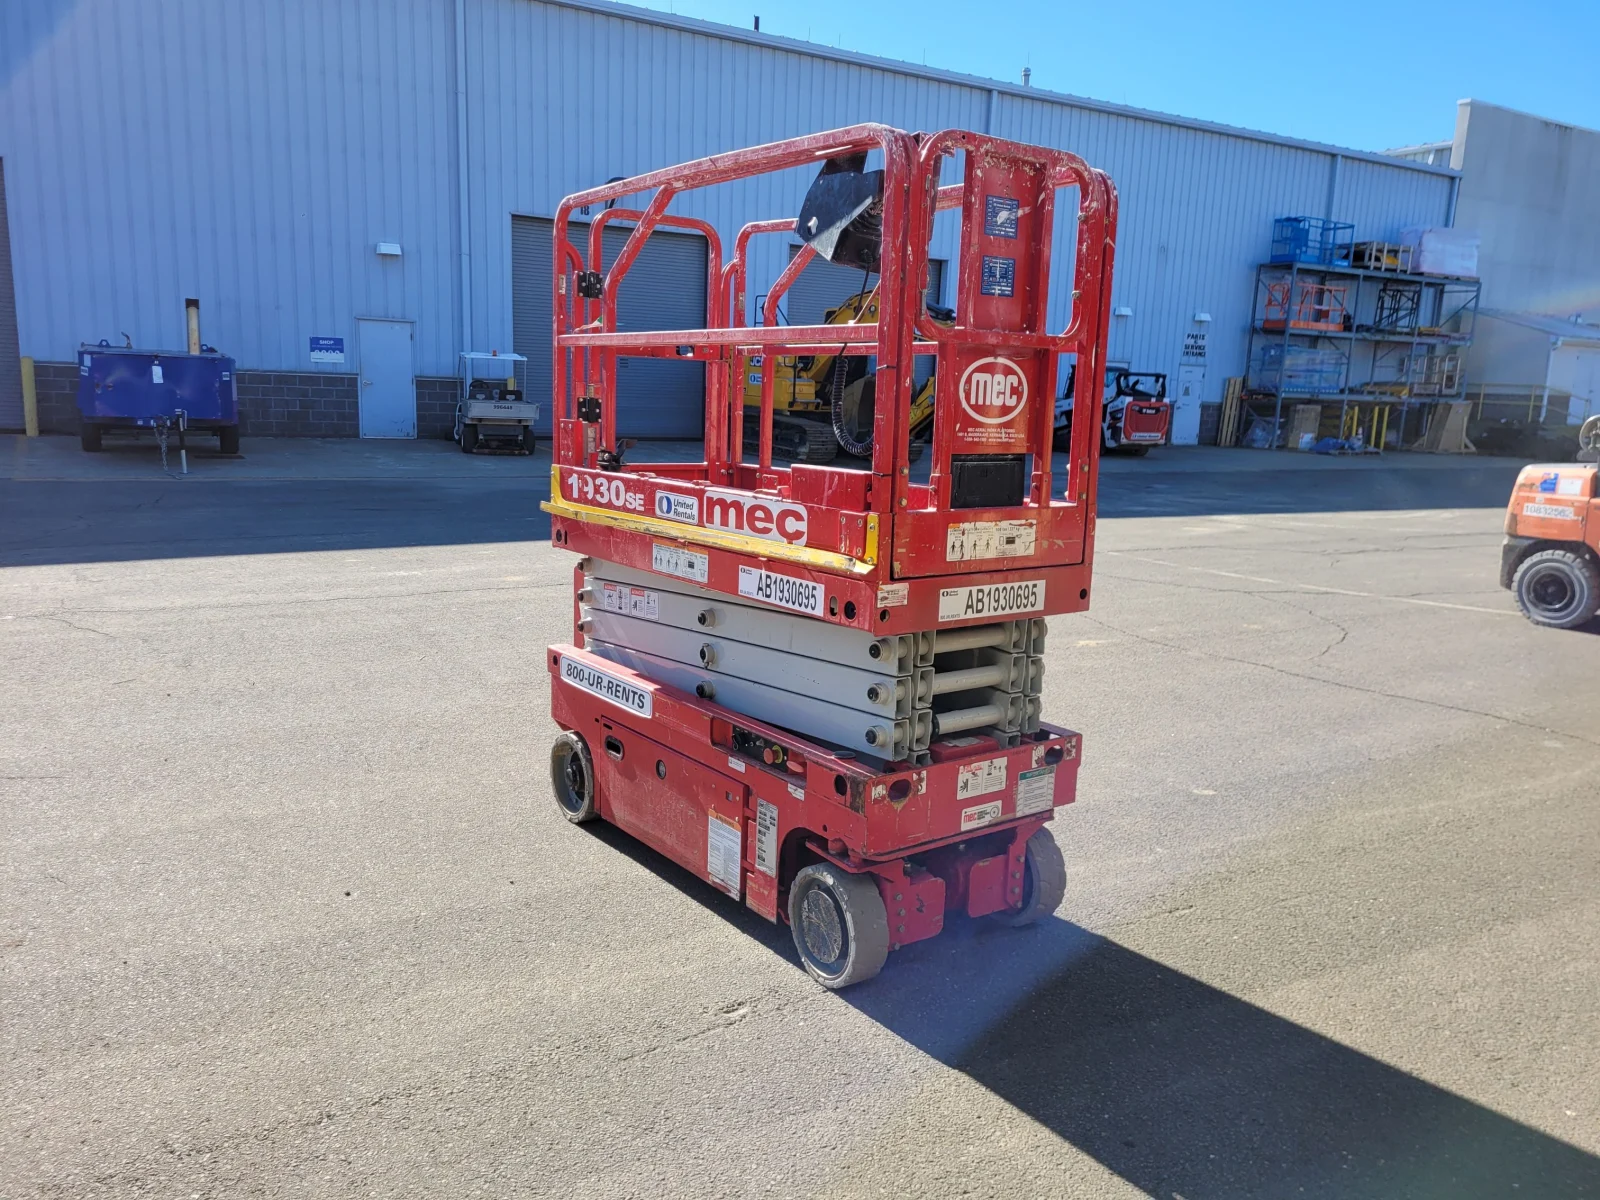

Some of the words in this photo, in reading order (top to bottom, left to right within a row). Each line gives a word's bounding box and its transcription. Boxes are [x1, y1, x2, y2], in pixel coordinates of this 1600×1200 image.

[1182, 350, 1206, 358] ENTRANCE
[750, 356, 763, 367] JC
[673, 498, 694, 511] United
[673, 510, 696, 521] Rentals
[756, 572, 817, 611] AB1930695
[963, 583, 1038, 616] AB1930695
[566, 663, 645, 709] 800-UR-RENTS
